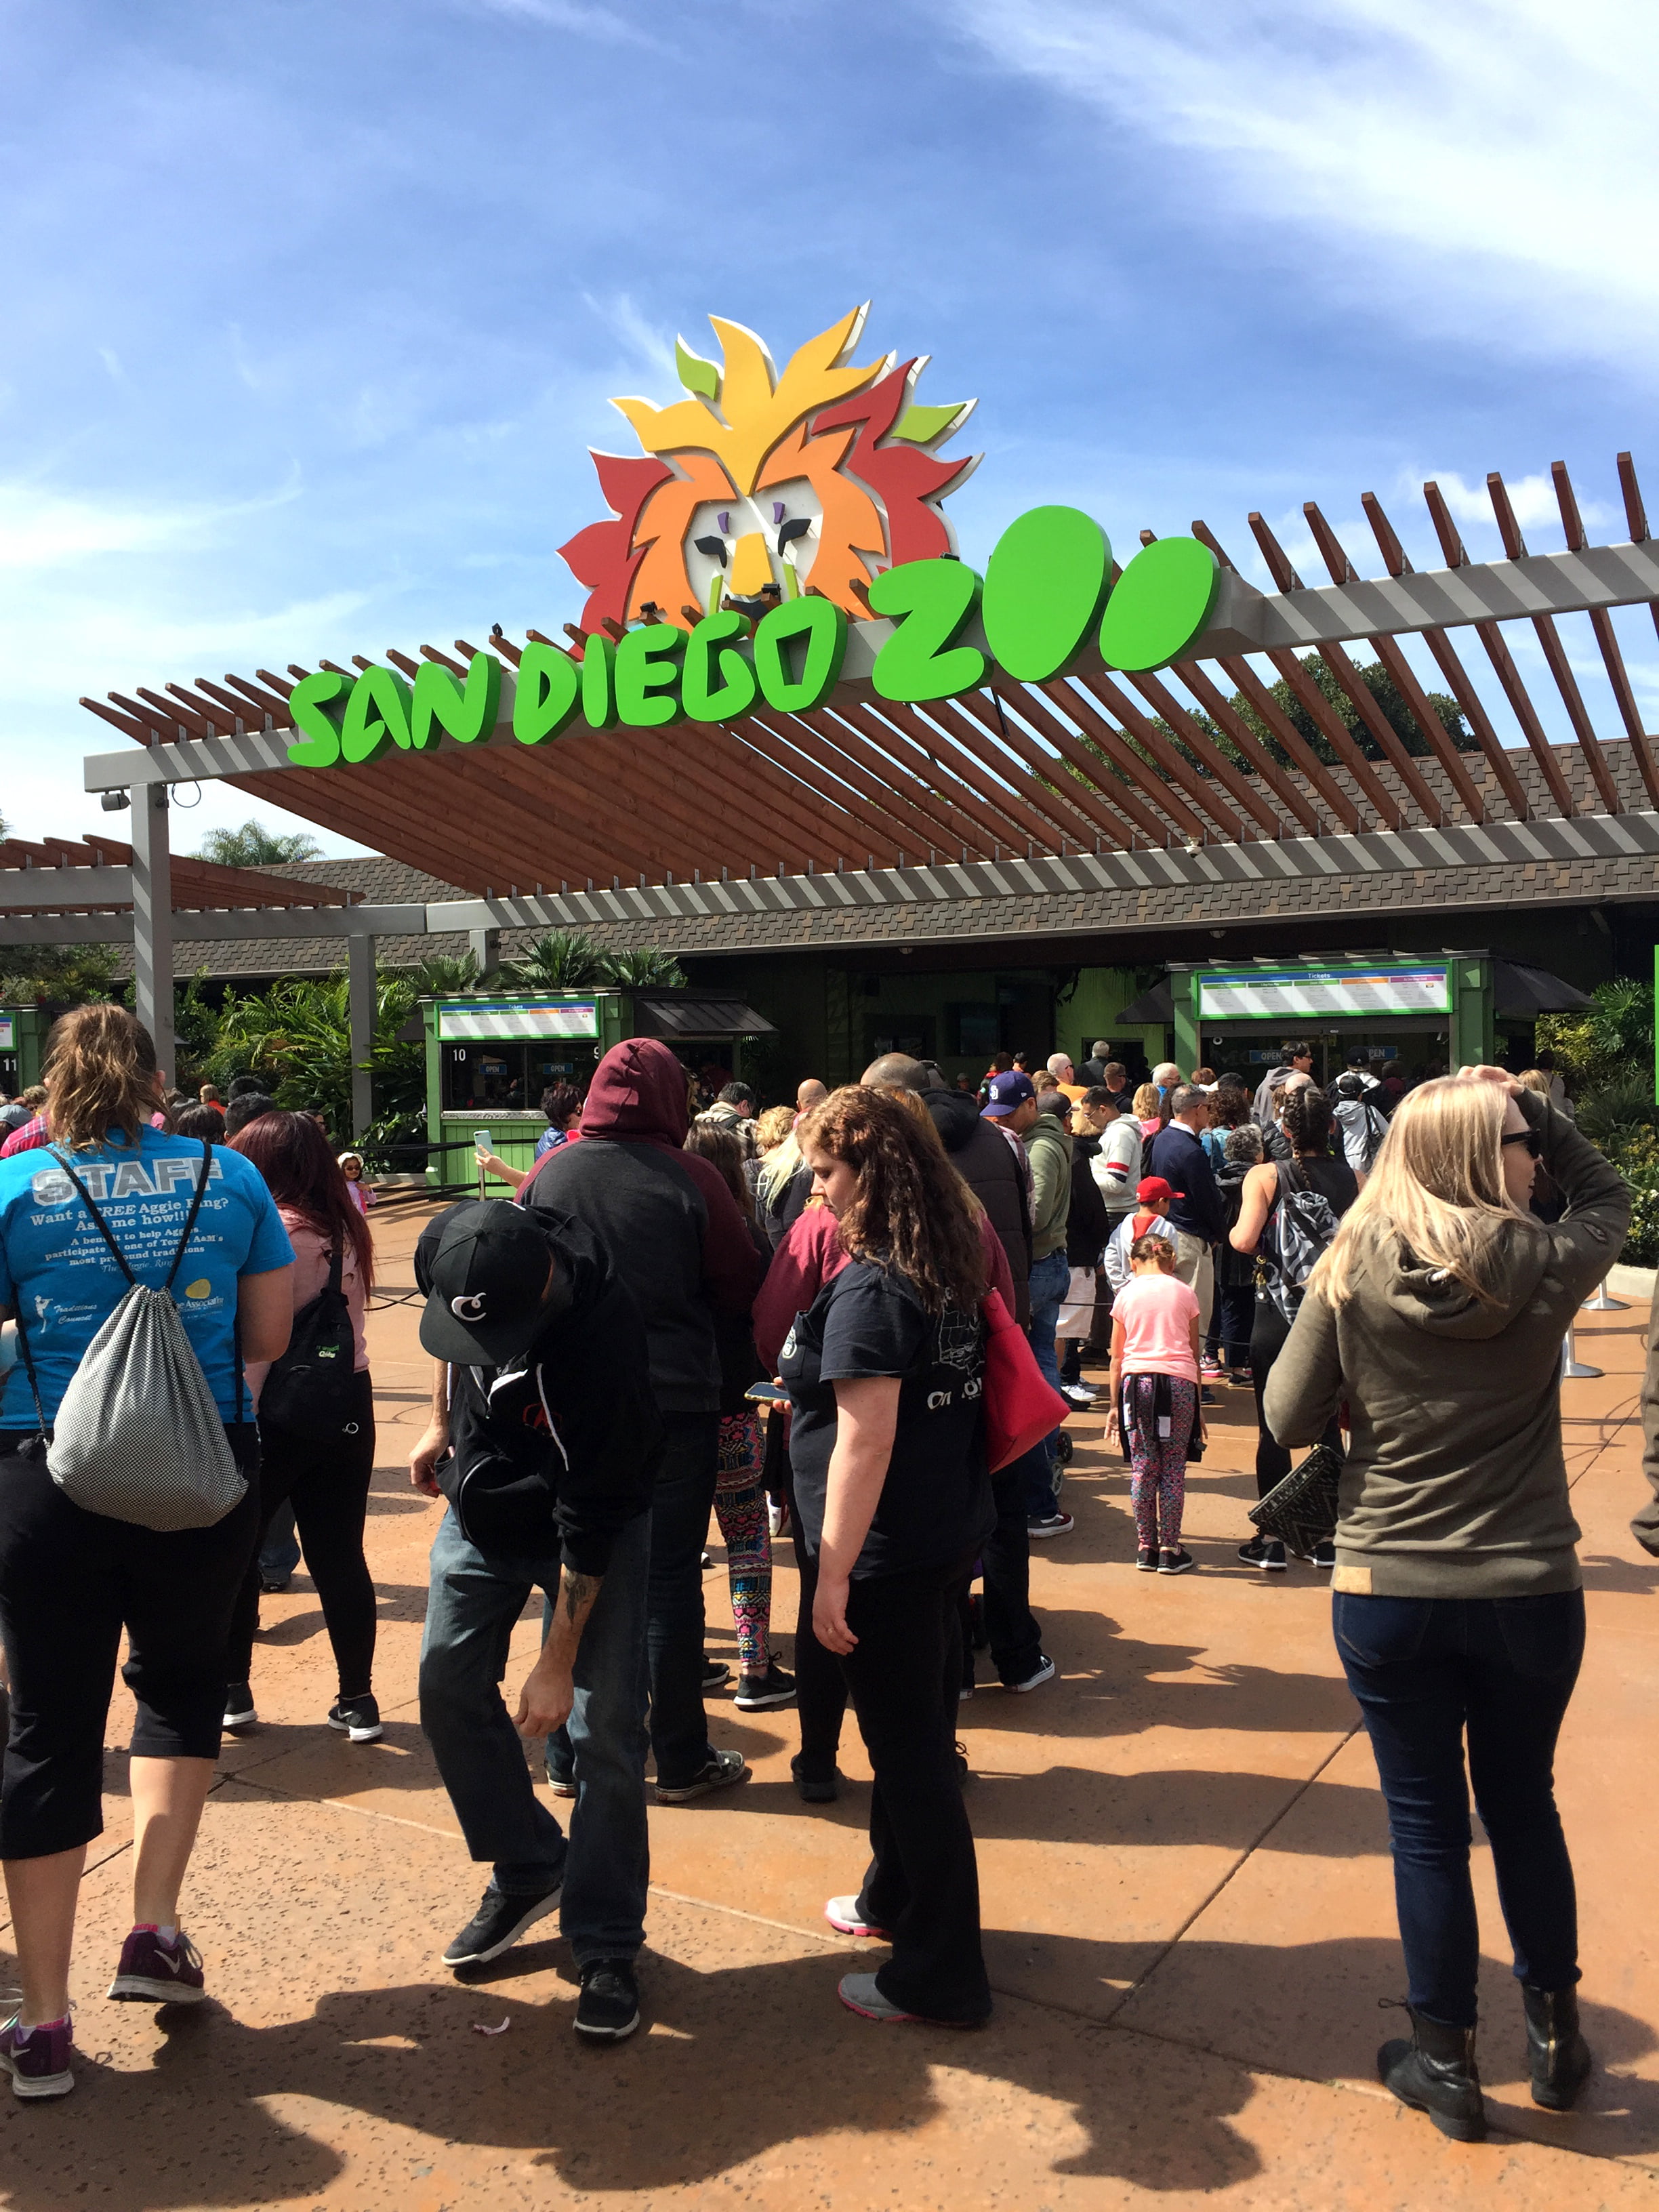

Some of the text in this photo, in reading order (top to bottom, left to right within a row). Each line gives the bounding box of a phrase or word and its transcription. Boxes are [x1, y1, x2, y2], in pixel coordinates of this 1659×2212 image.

[287, 505, 1219, 768] SAN DIEGO ZOO
[453, 1049, 466, 1061] 10
[1261, 1052, 1282, 1061] OPEN
[1368, 1049, 1385, 1057] PEN
[3, 1058, 17, 1071] 11
[32, 1158, 224, 1206] STAFF
[30, 1210, 73, 1226] Want
[78, 1210, 87, 1219] a
[91, 1204, 136, 1217] REE
[139, 1200, 181, 1214] Aggie
[75, 1210, 190, 1231] As me how!!!
[83, 1234, 121, 1244] beneit
[139, 1231, 161, 1240] help
[165, 1227, 199, 1237] Aggs
[45, 1246, 106, 1261] participate
[146, 1240, 157, 1248] of
[160, 1238, 190, 1246] Tex
[69, 1246, 205, 1266] most proound tradions
[54, 1305, 97, 1313] Traditions
[451, 1292, 487, 1322] C
[58, 1314, 93, 1324] Council
